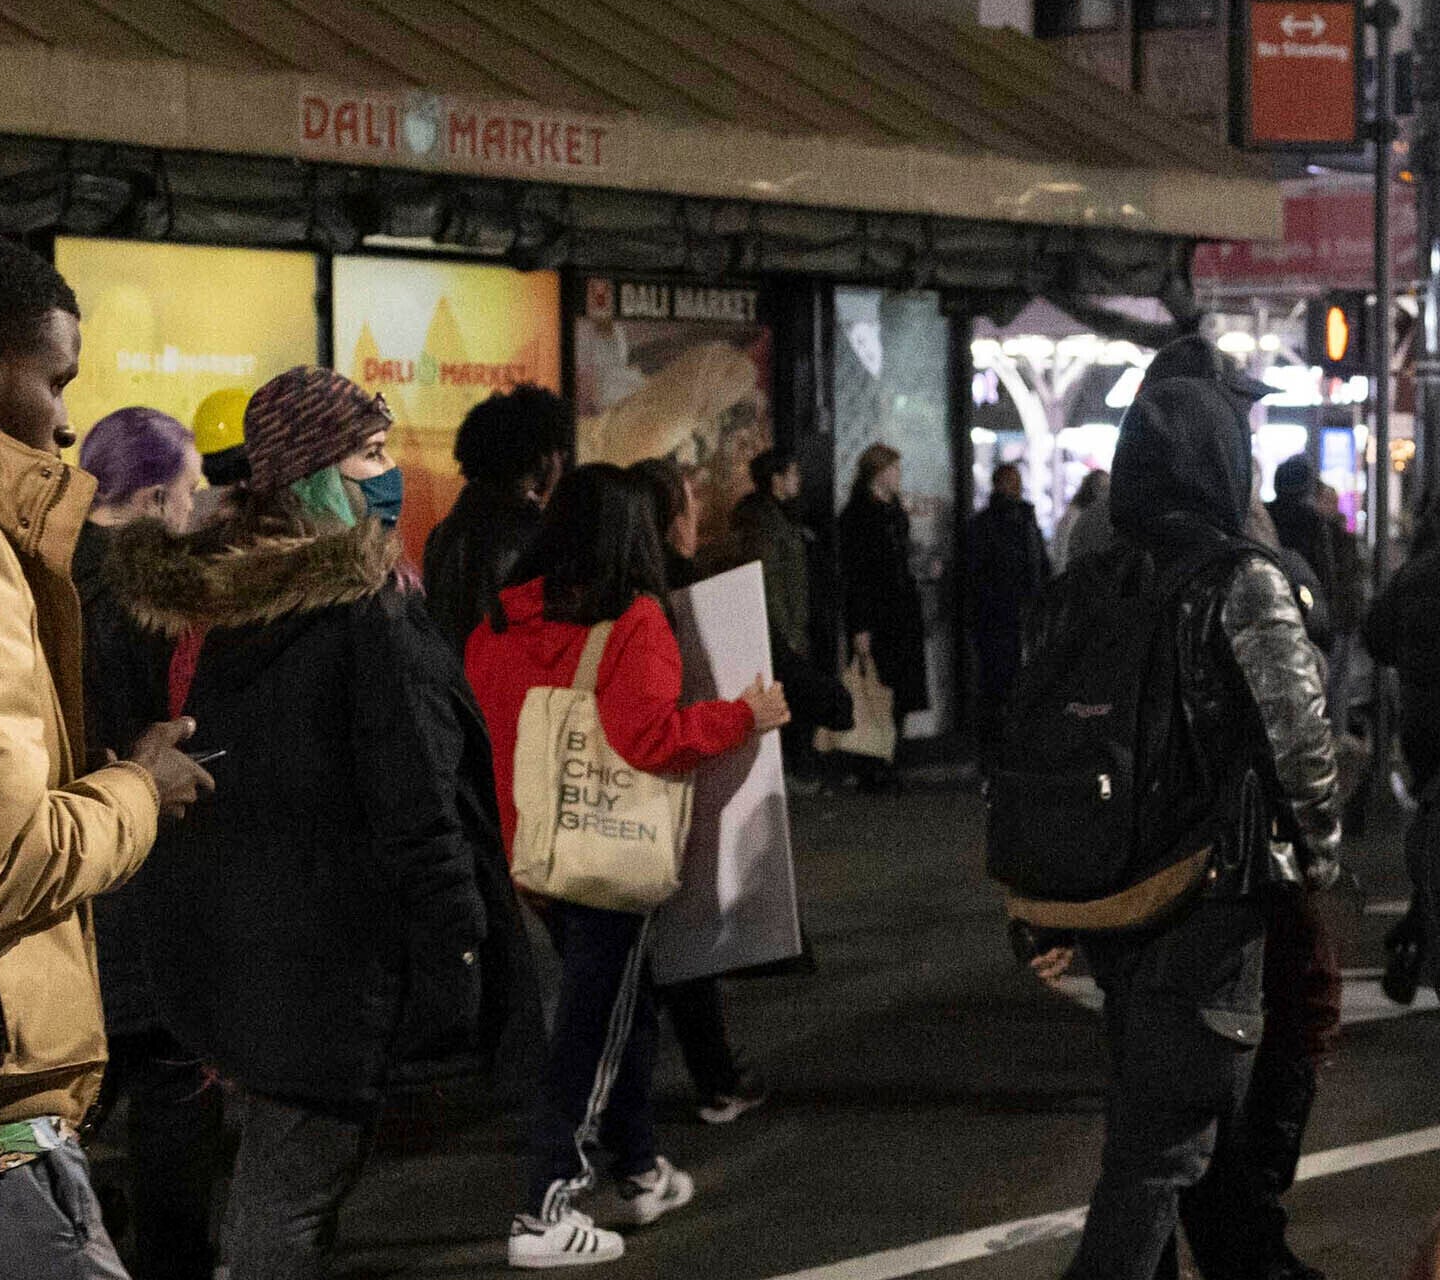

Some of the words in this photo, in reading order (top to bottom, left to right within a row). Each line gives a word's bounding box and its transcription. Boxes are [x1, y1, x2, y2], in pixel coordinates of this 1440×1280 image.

[303, 96, 397, 152] DALI
[447, 111, 605, 166] MARKET
[567, 730, 587, 751] B
[564, 758, 633, 788] CHIC
[560, 783, 621, 811] BUY
[559, 811, 657, 842] GREEN
